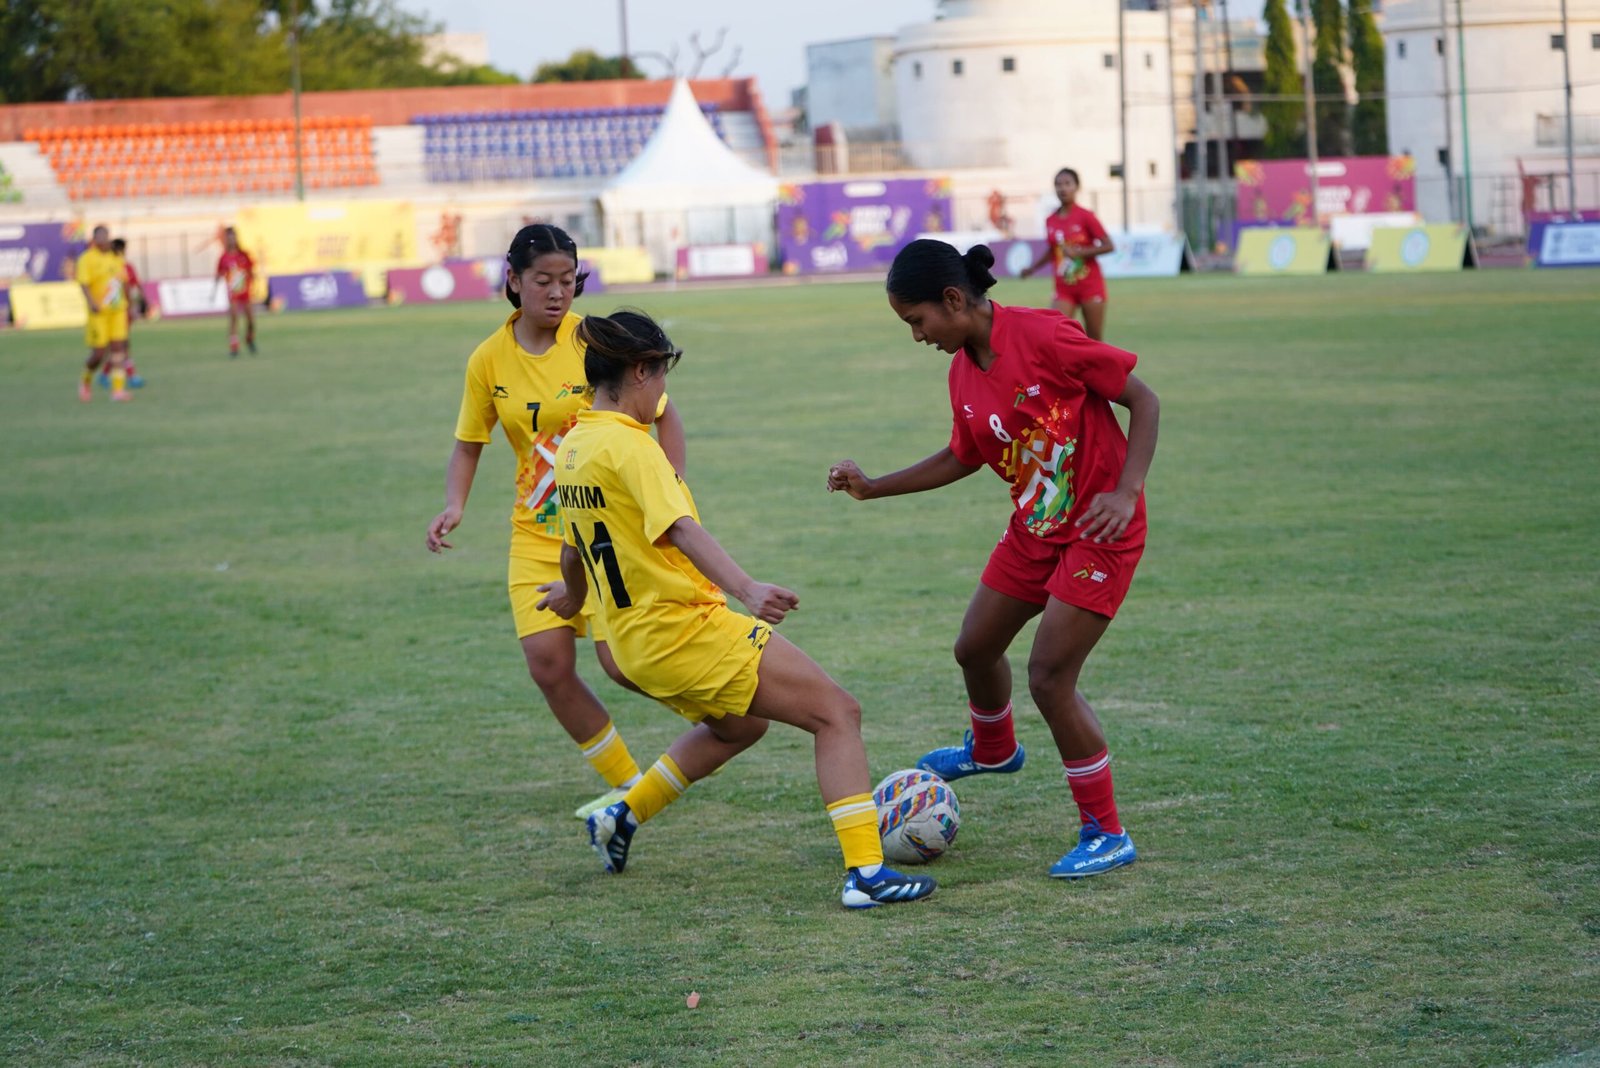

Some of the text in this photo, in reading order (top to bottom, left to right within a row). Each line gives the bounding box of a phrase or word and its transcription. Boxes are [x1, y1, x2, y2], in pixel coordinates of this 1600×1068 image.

[526, 402, 541, 432] 7
[989, 413, 1012, 443] 8
[558, 484, 607, 509] IKKIM
